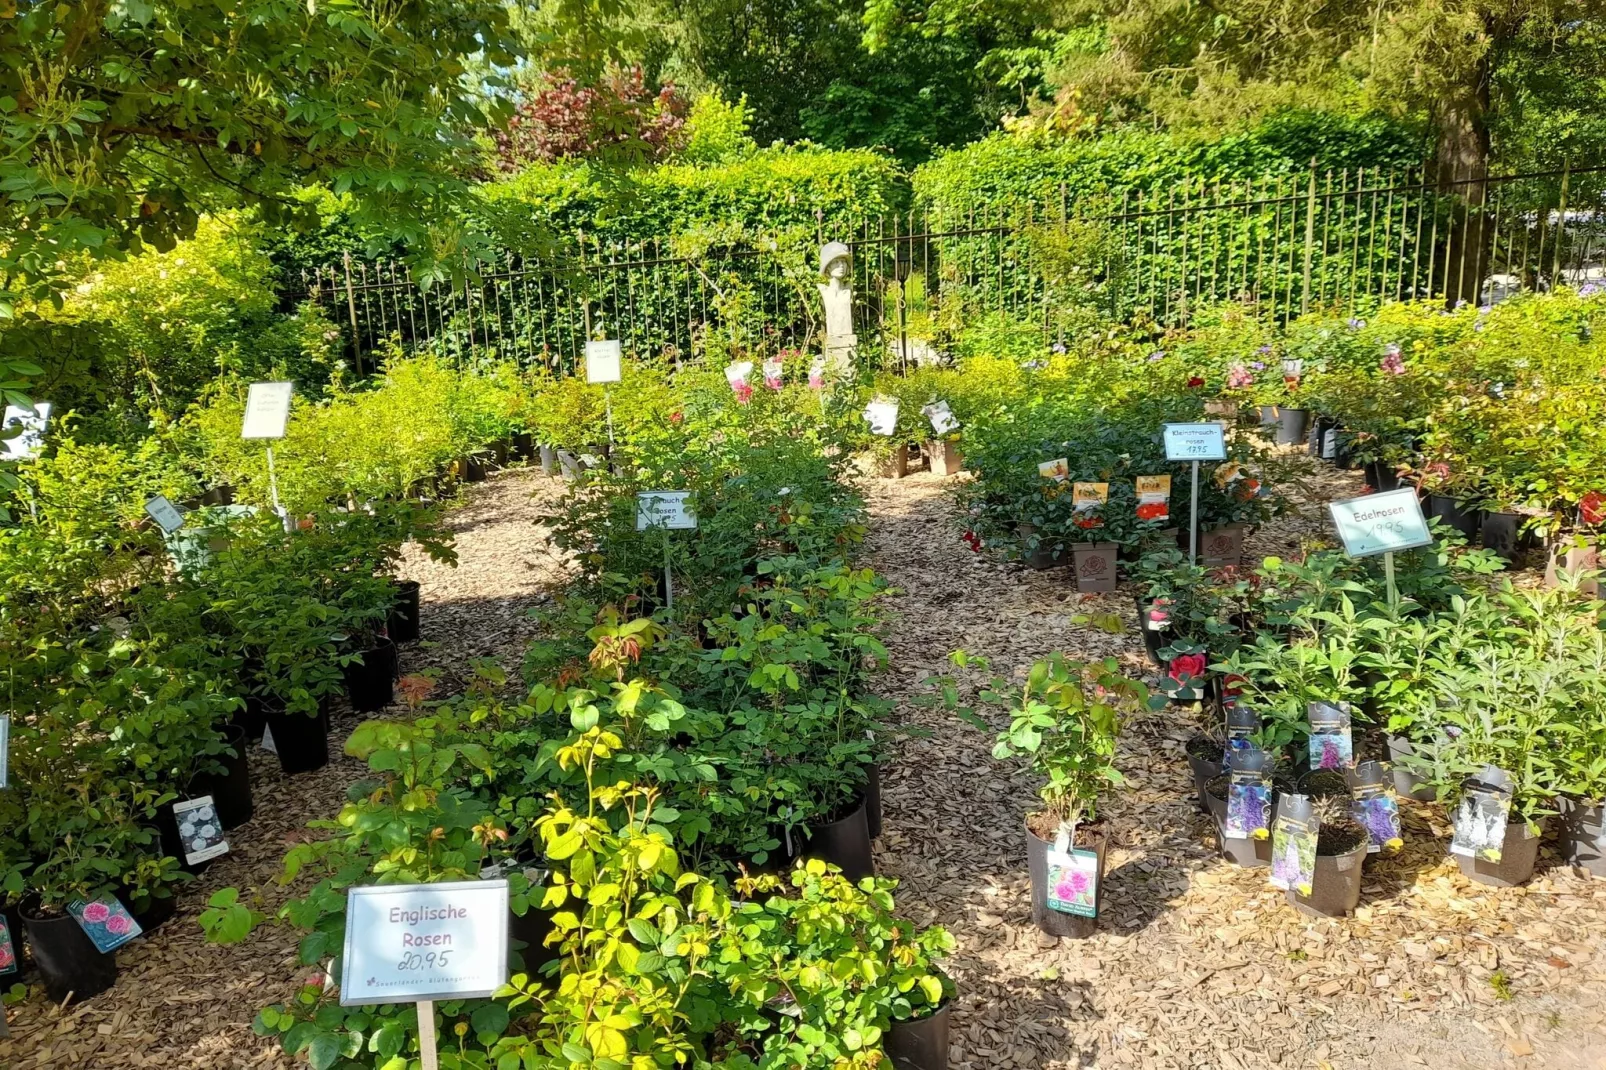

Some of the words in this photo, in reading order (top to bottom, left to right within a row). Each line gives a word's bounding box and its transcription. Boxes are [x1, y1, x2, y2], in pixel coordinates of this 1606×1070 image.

[1353, 506, 1405, 523] Edelrosen
[389, 904, 467, 926] Englische
[402, 932, 452, 948] Rosen
